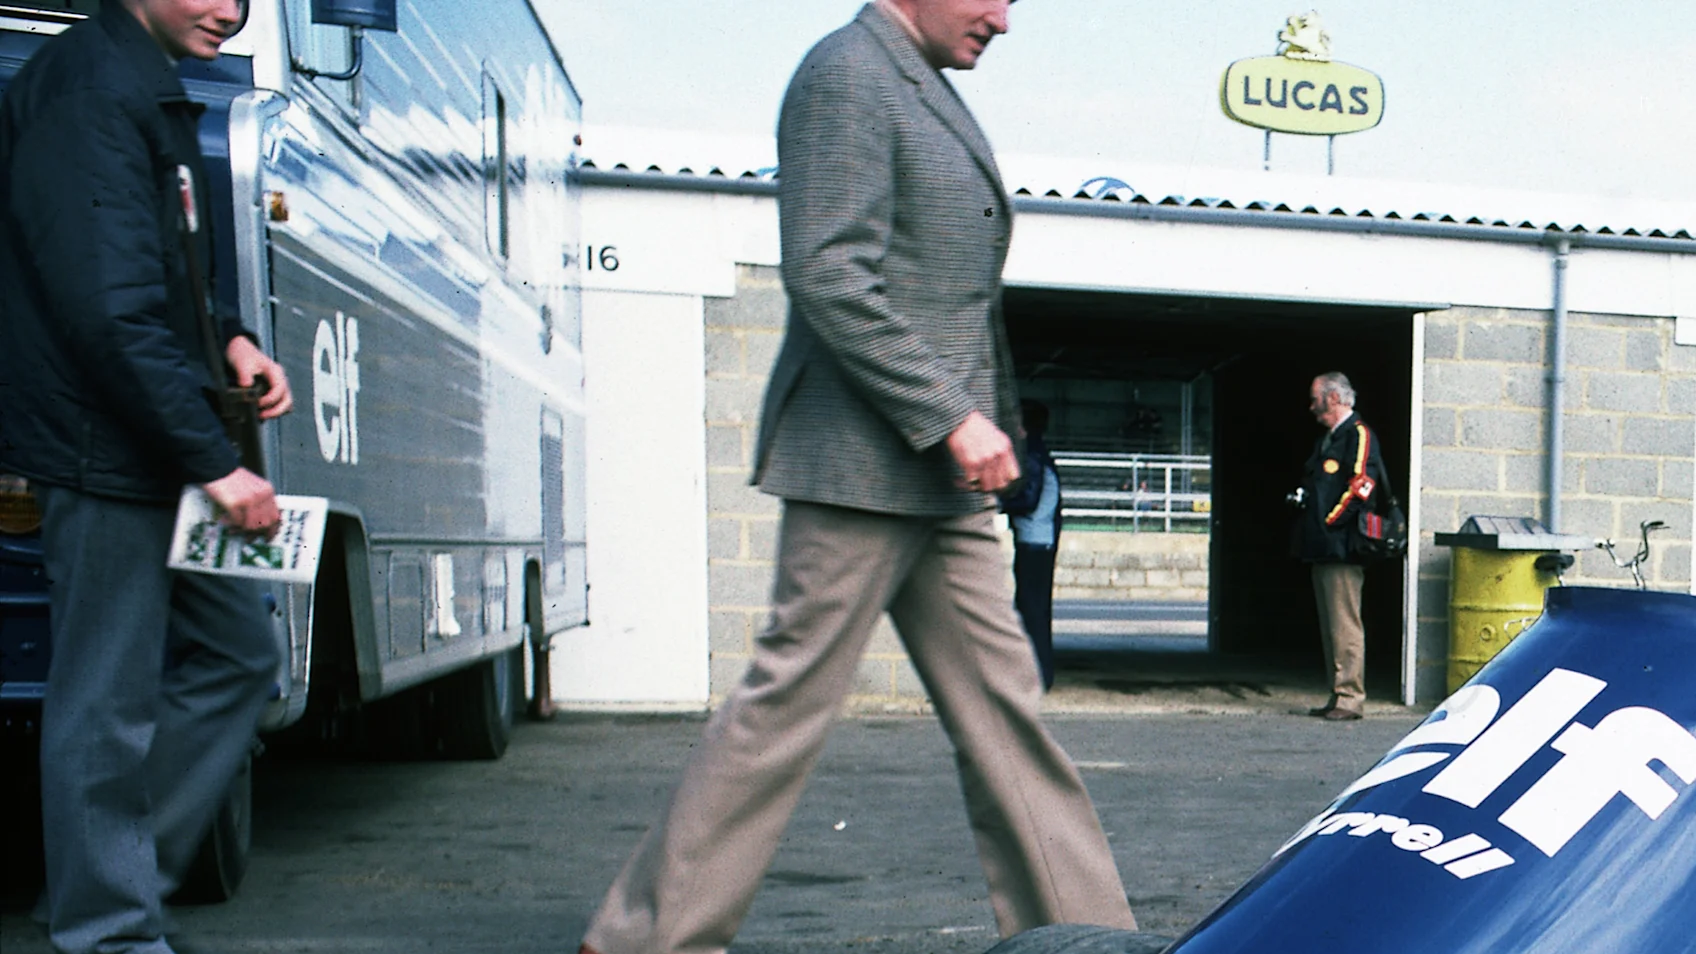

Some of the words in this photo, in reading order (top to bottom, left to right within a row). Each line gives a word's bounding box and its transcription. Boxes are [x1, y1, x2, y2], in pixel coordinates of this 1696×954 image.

[1243, 75, 1369, 115] LUCAS
[587, 244, 620, 271] 16
[313, 311, 361, 465] elf
